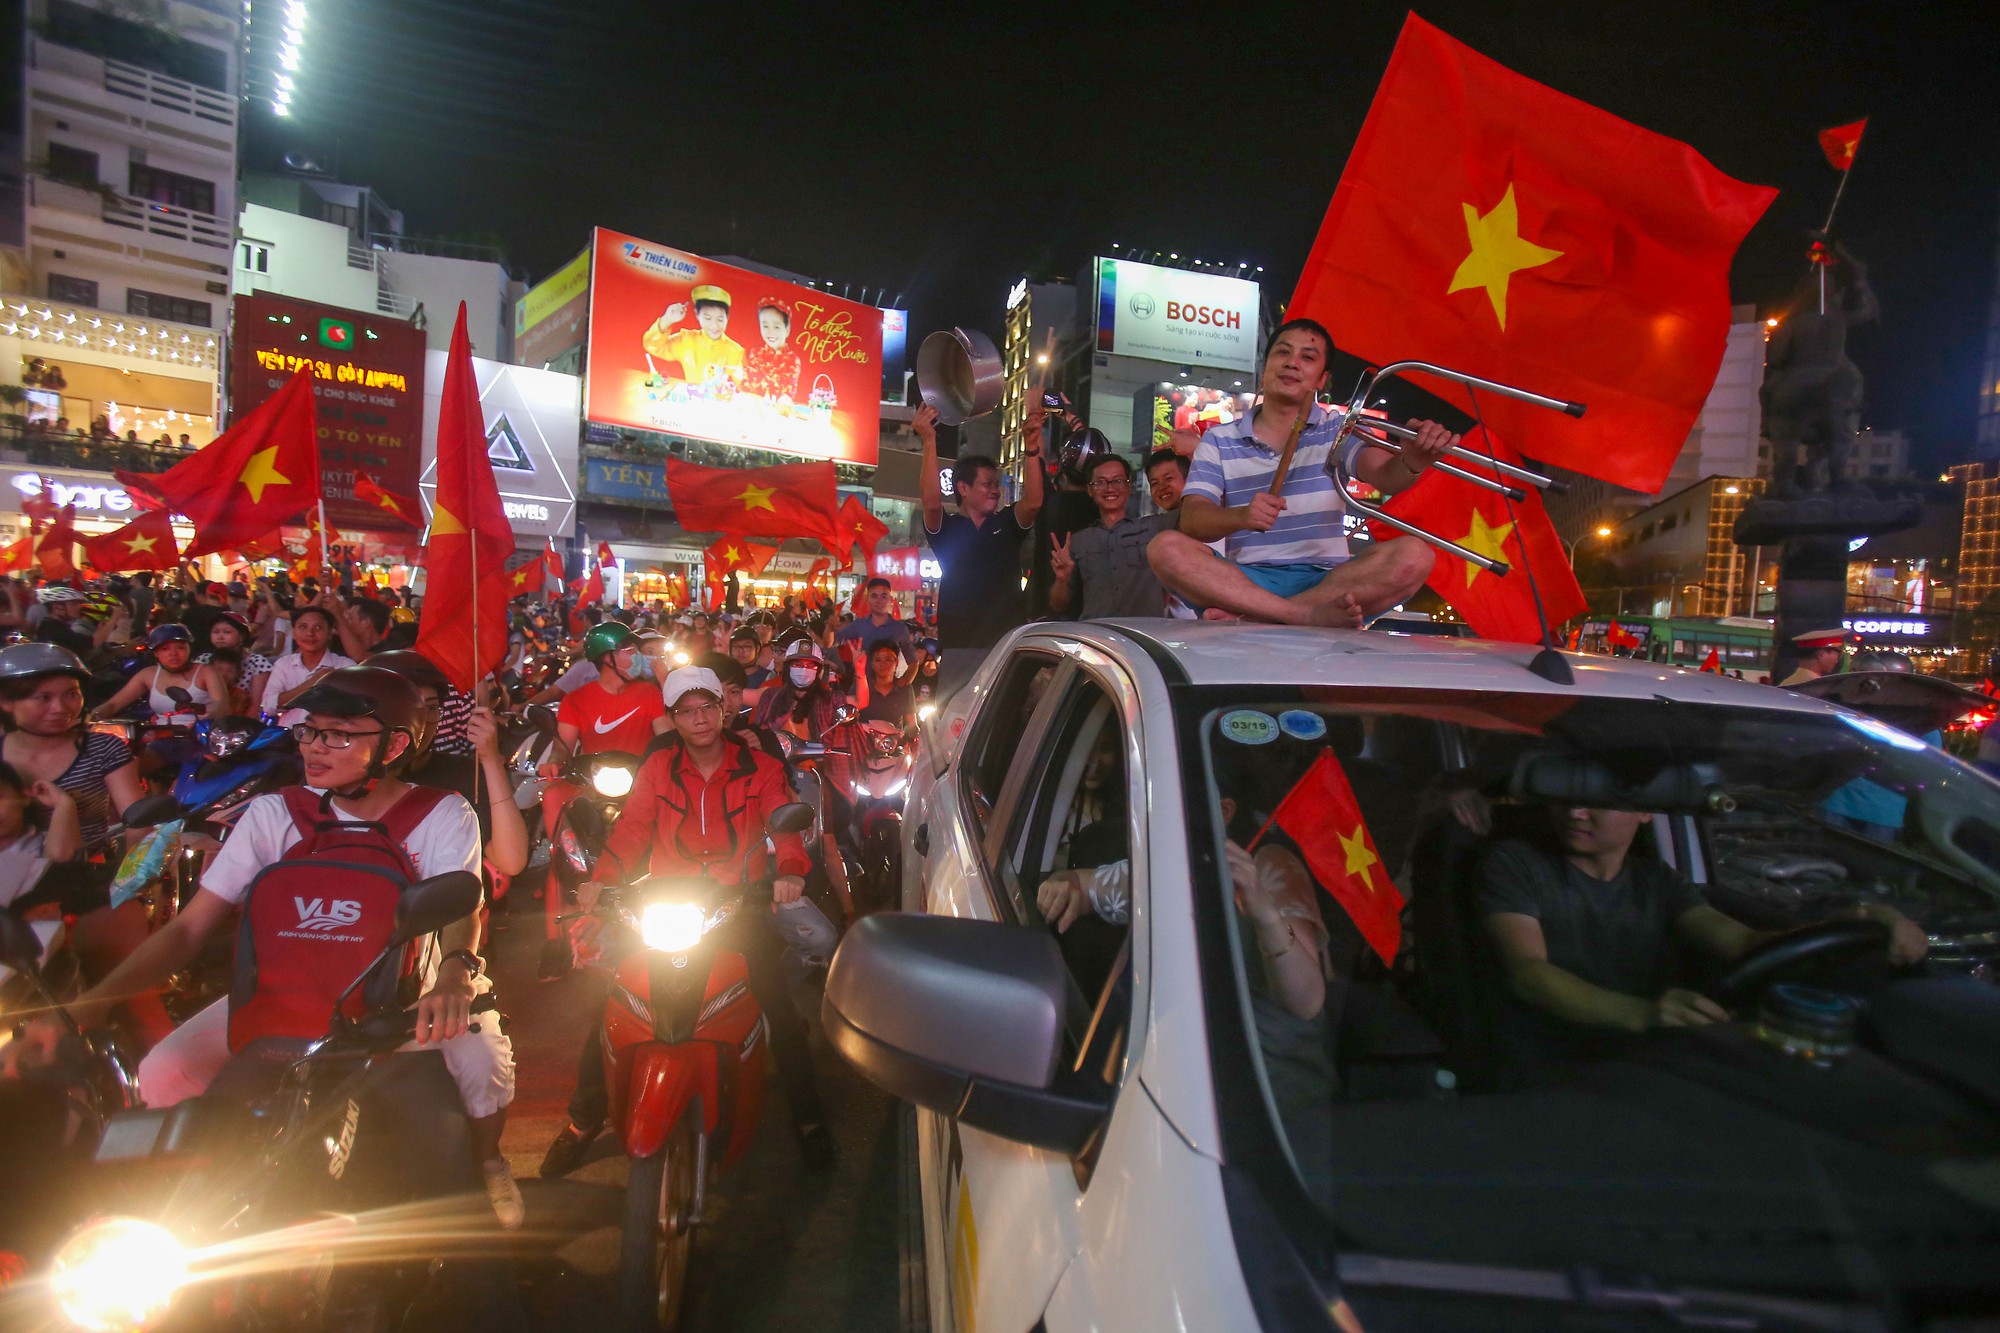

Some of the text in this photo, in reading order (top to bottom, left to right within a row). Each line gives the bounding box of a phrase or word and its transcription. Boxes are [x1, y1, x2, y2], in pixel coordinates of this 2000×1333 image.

[645, 250, 671, 268] THIÊN
[673, 261, 697, 275] LONG
[1167, 301, 1240, 330] BOSCH
[1166, 324, 1184, 335] Sáng
[323, 387, 344, 400] CHO
[601, 463, 653, 487] YẾN
[1853, 620, 1928, 636] COFFEE
[1231, 721, 1268, 731] 03/19
[294, 896, 362, 924] VUS
[277, 930, 298, 938] ANH
[328, 1098, 360, 1180] SUZUKI
